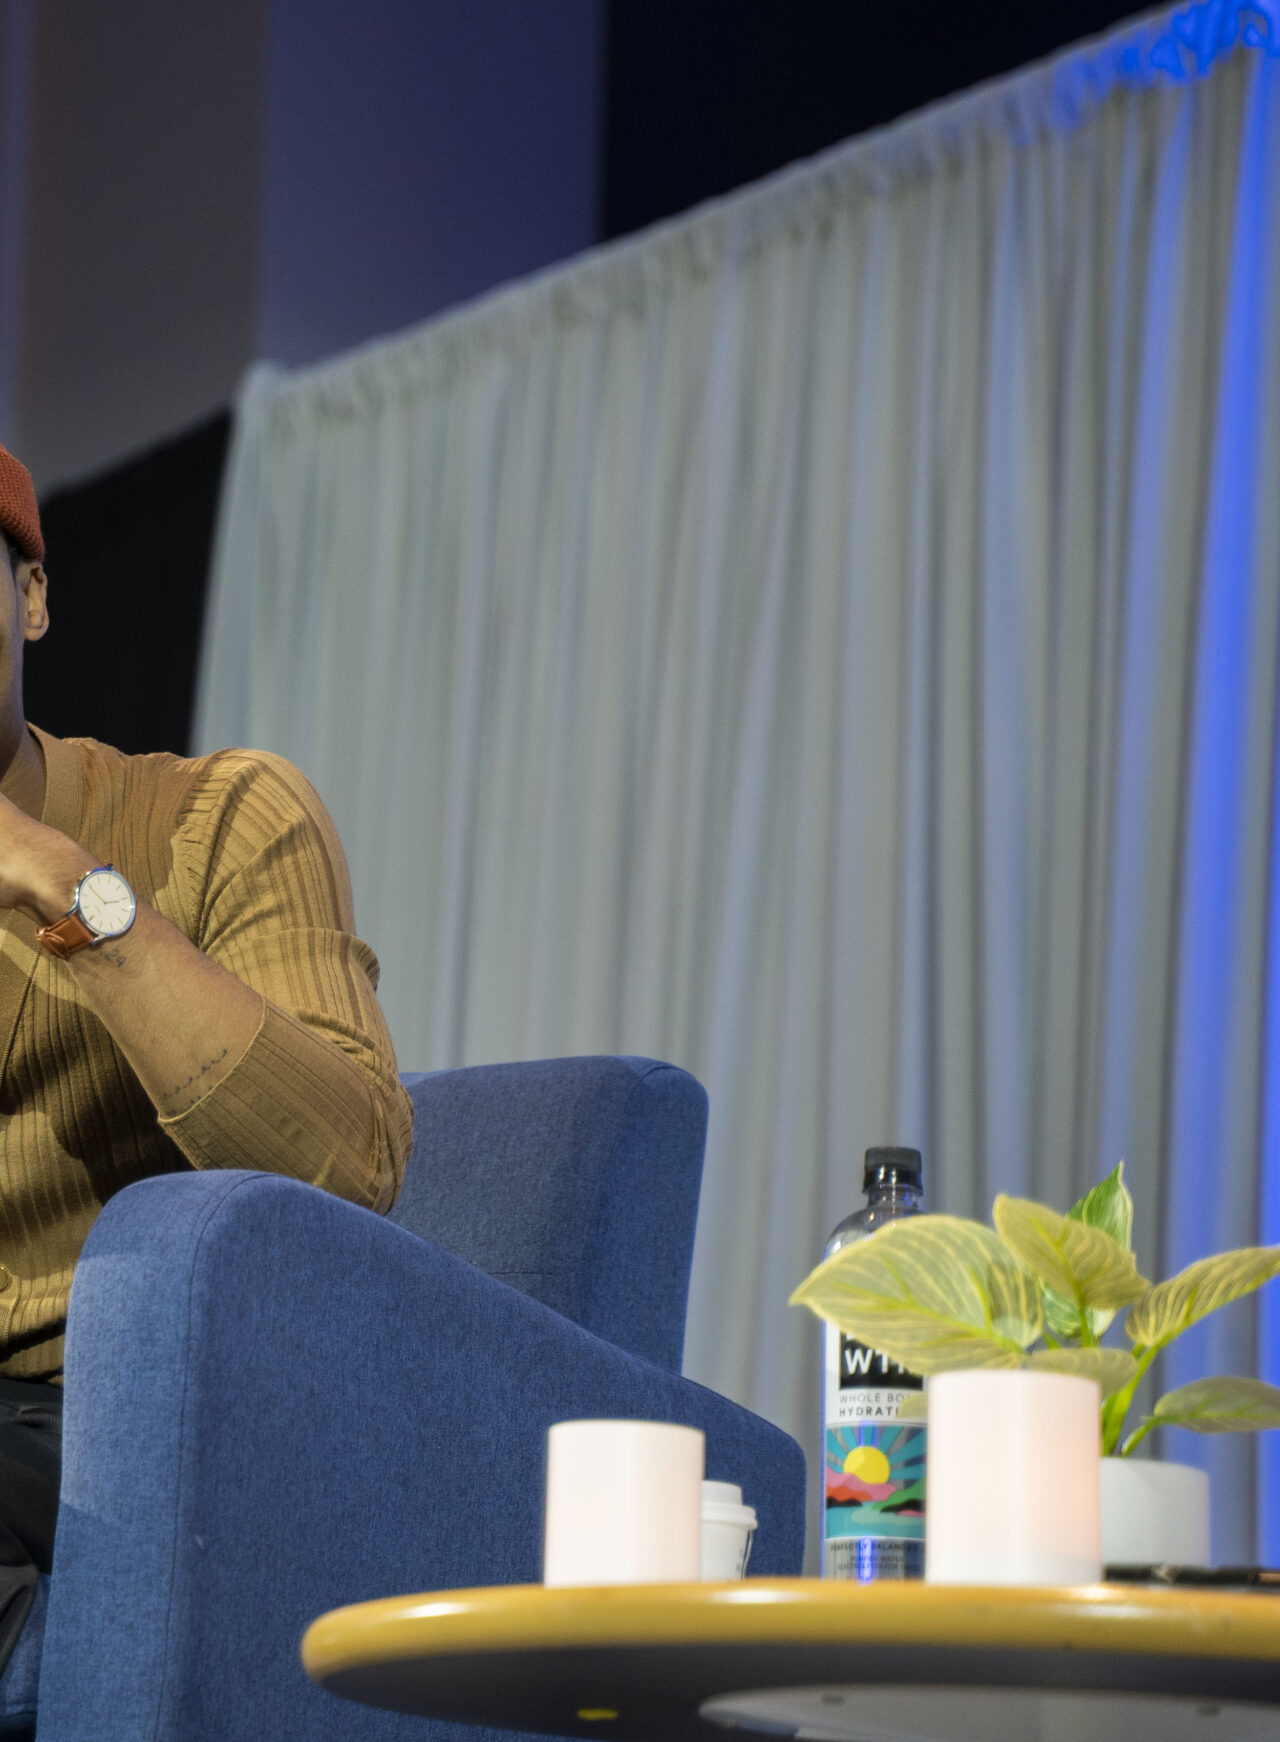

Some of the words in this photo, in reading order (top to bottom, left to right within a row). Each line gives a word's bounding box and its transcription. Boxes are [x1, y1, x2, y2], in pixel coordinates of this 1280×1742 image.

[844, 1349, 912, 1374] WT
[839, 1391, 881, 1404] WHOLE
[839, 1405, 899, 1417] HYDRATI
